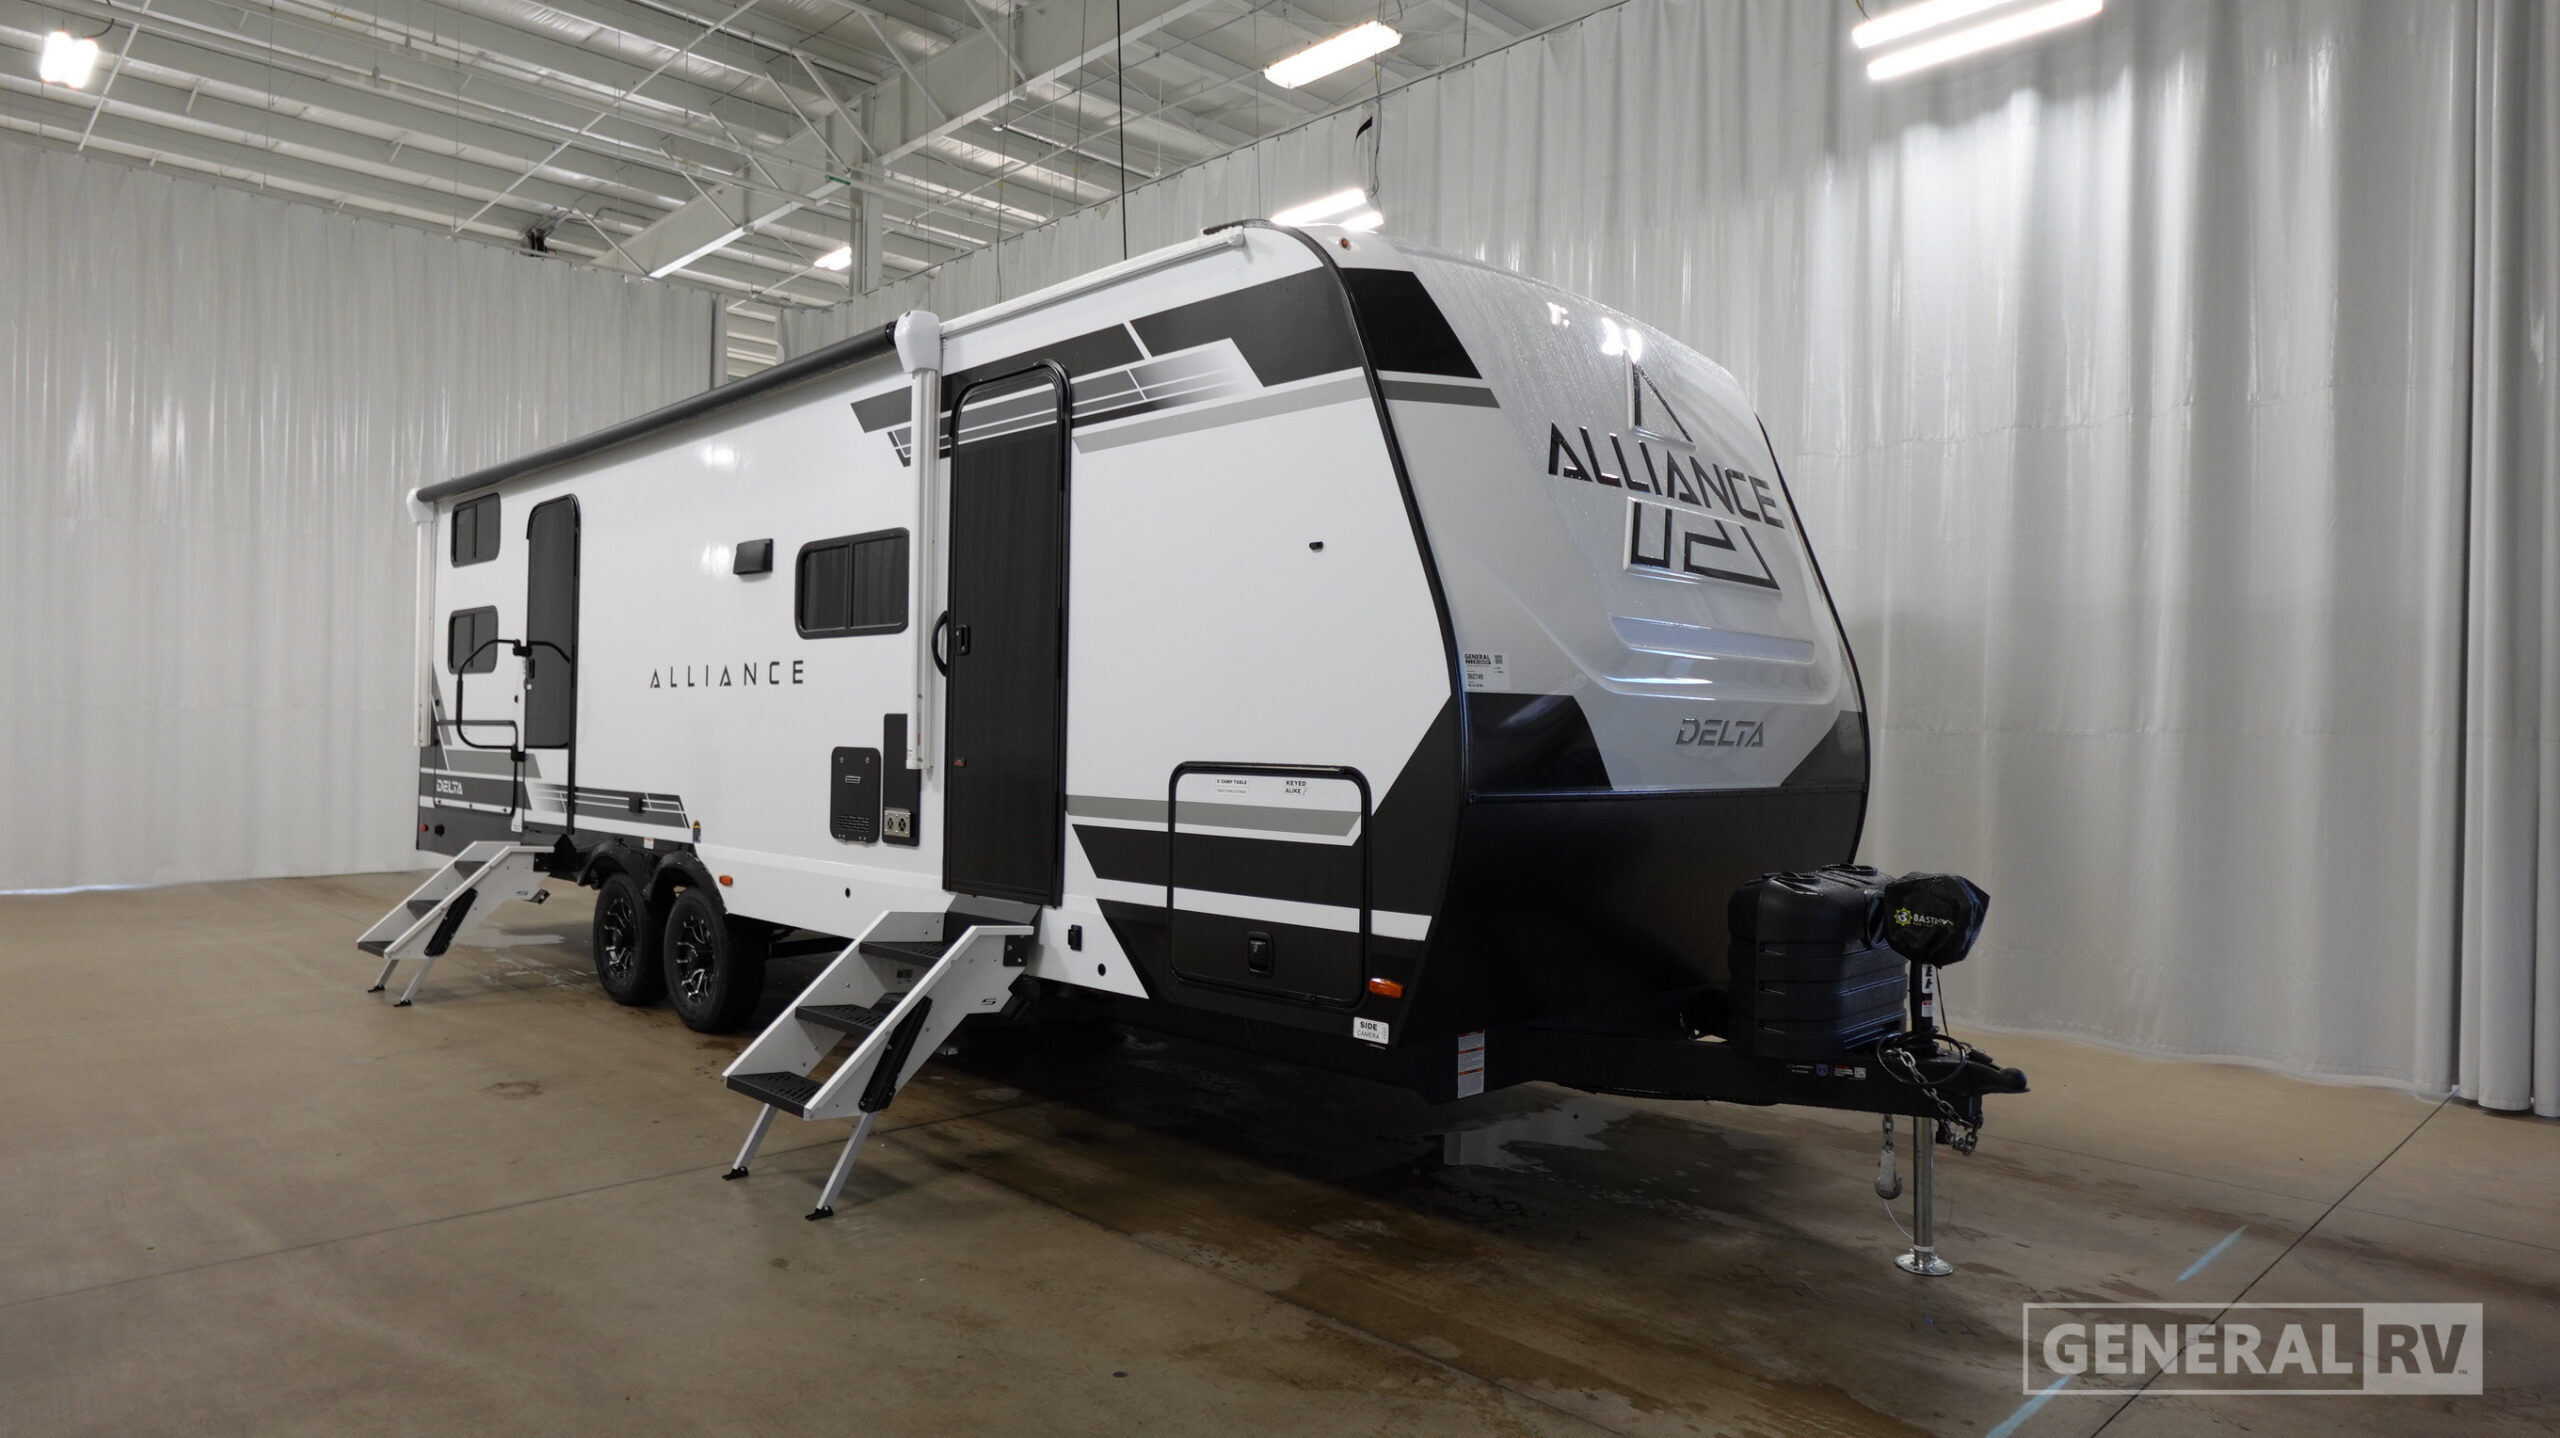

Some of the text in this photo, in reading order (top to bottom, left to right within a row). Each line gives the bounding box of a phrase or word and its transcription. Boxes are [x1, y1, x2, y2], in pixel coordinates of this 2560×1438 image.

[1548, 421, 1785, 529] ALLIANCE
[650, 660, 804, 689] ALLIANCE
[1675, 717, 1764, 748] DELTA
[436, 779, 463, 795] DELTA
[1357, 1030, 1380, 1040] CAMERA
[1360, 1021, 1378, 1031] SIDE
